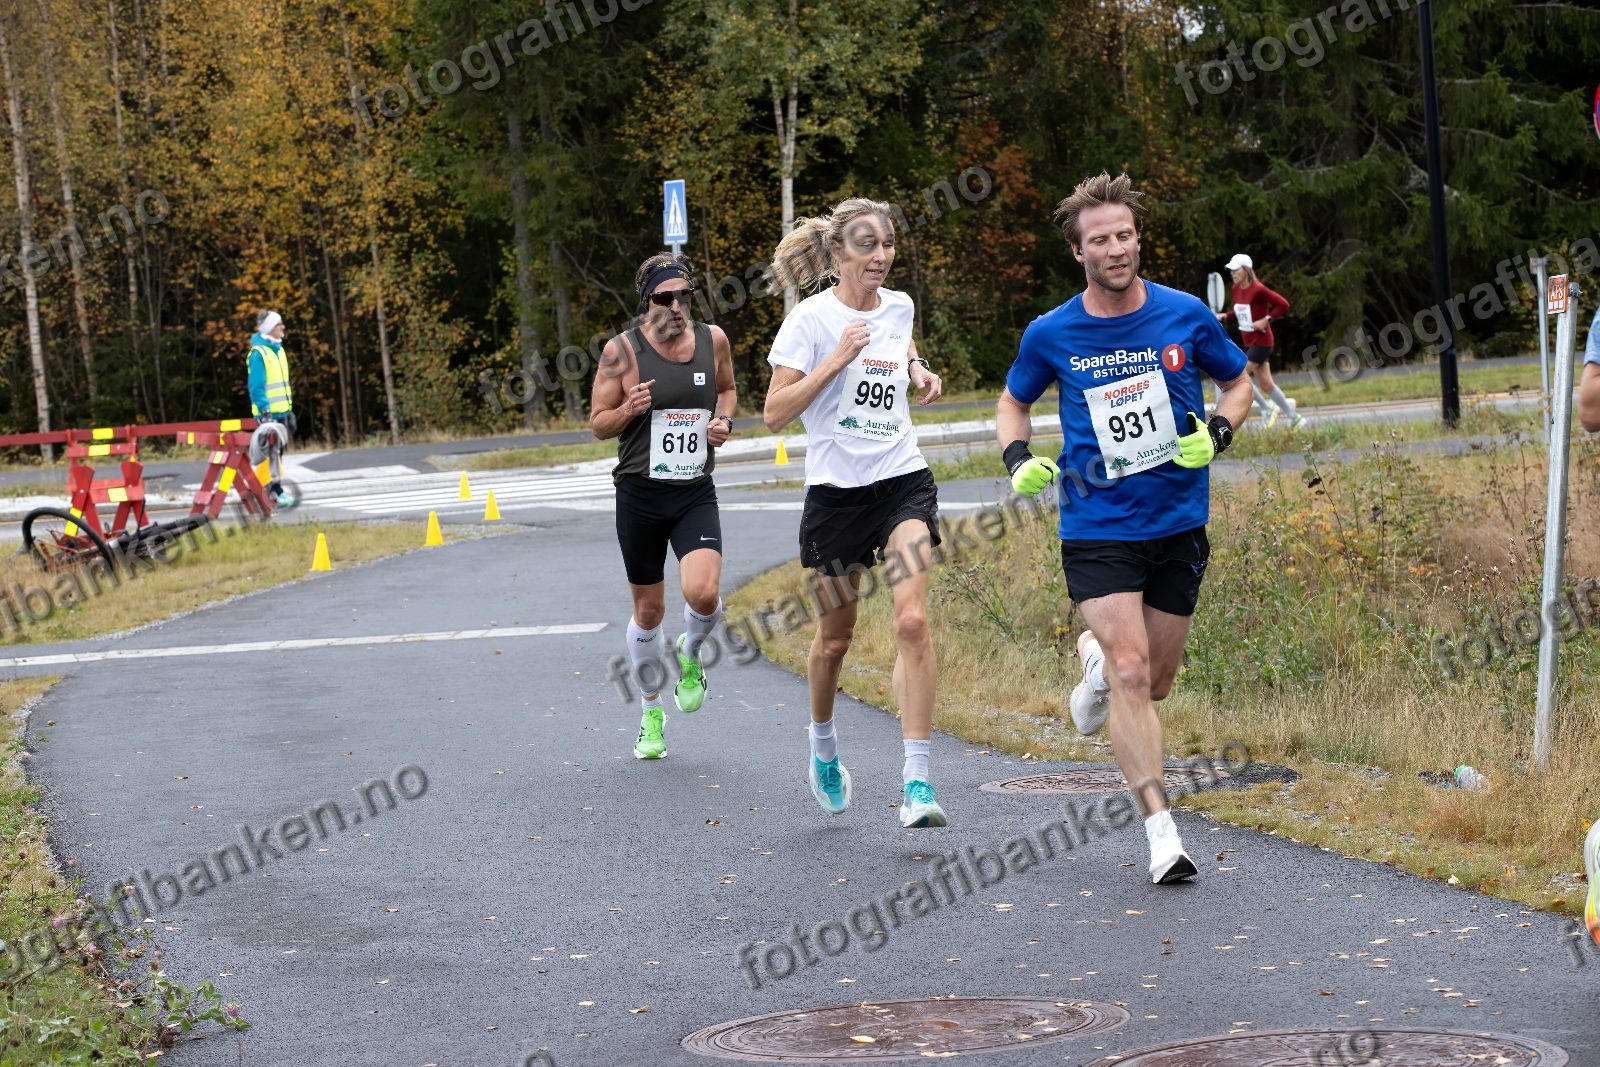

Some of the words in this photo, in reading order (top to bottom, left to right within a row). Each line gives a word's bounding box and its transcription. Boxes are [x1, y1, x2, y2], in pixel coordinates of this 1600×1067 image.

[861, 358, 899, 370] NORGES
[1069, 347, 1159, 372] SpareBank
[1168, 348, 1179, 367] 1
[865, 366, 894, 377] LØPET
[1093, 363, 1160, 379] ØSTLANDET
[855, 380, 896, 411] 996
[1104, 380, 1150, 401] NORGES
[1110, 391, 1145, 409] LØPET
[666, 413, 702, 421] NORGES
[668, 420, 696, 428] LØPET
[1108, 406, 1157, 443] 931
[863, 419, 900, 434] Aurskog
[662, 432, 699, 454] 618
[1136, 439, 1177, 461] Aurskog
